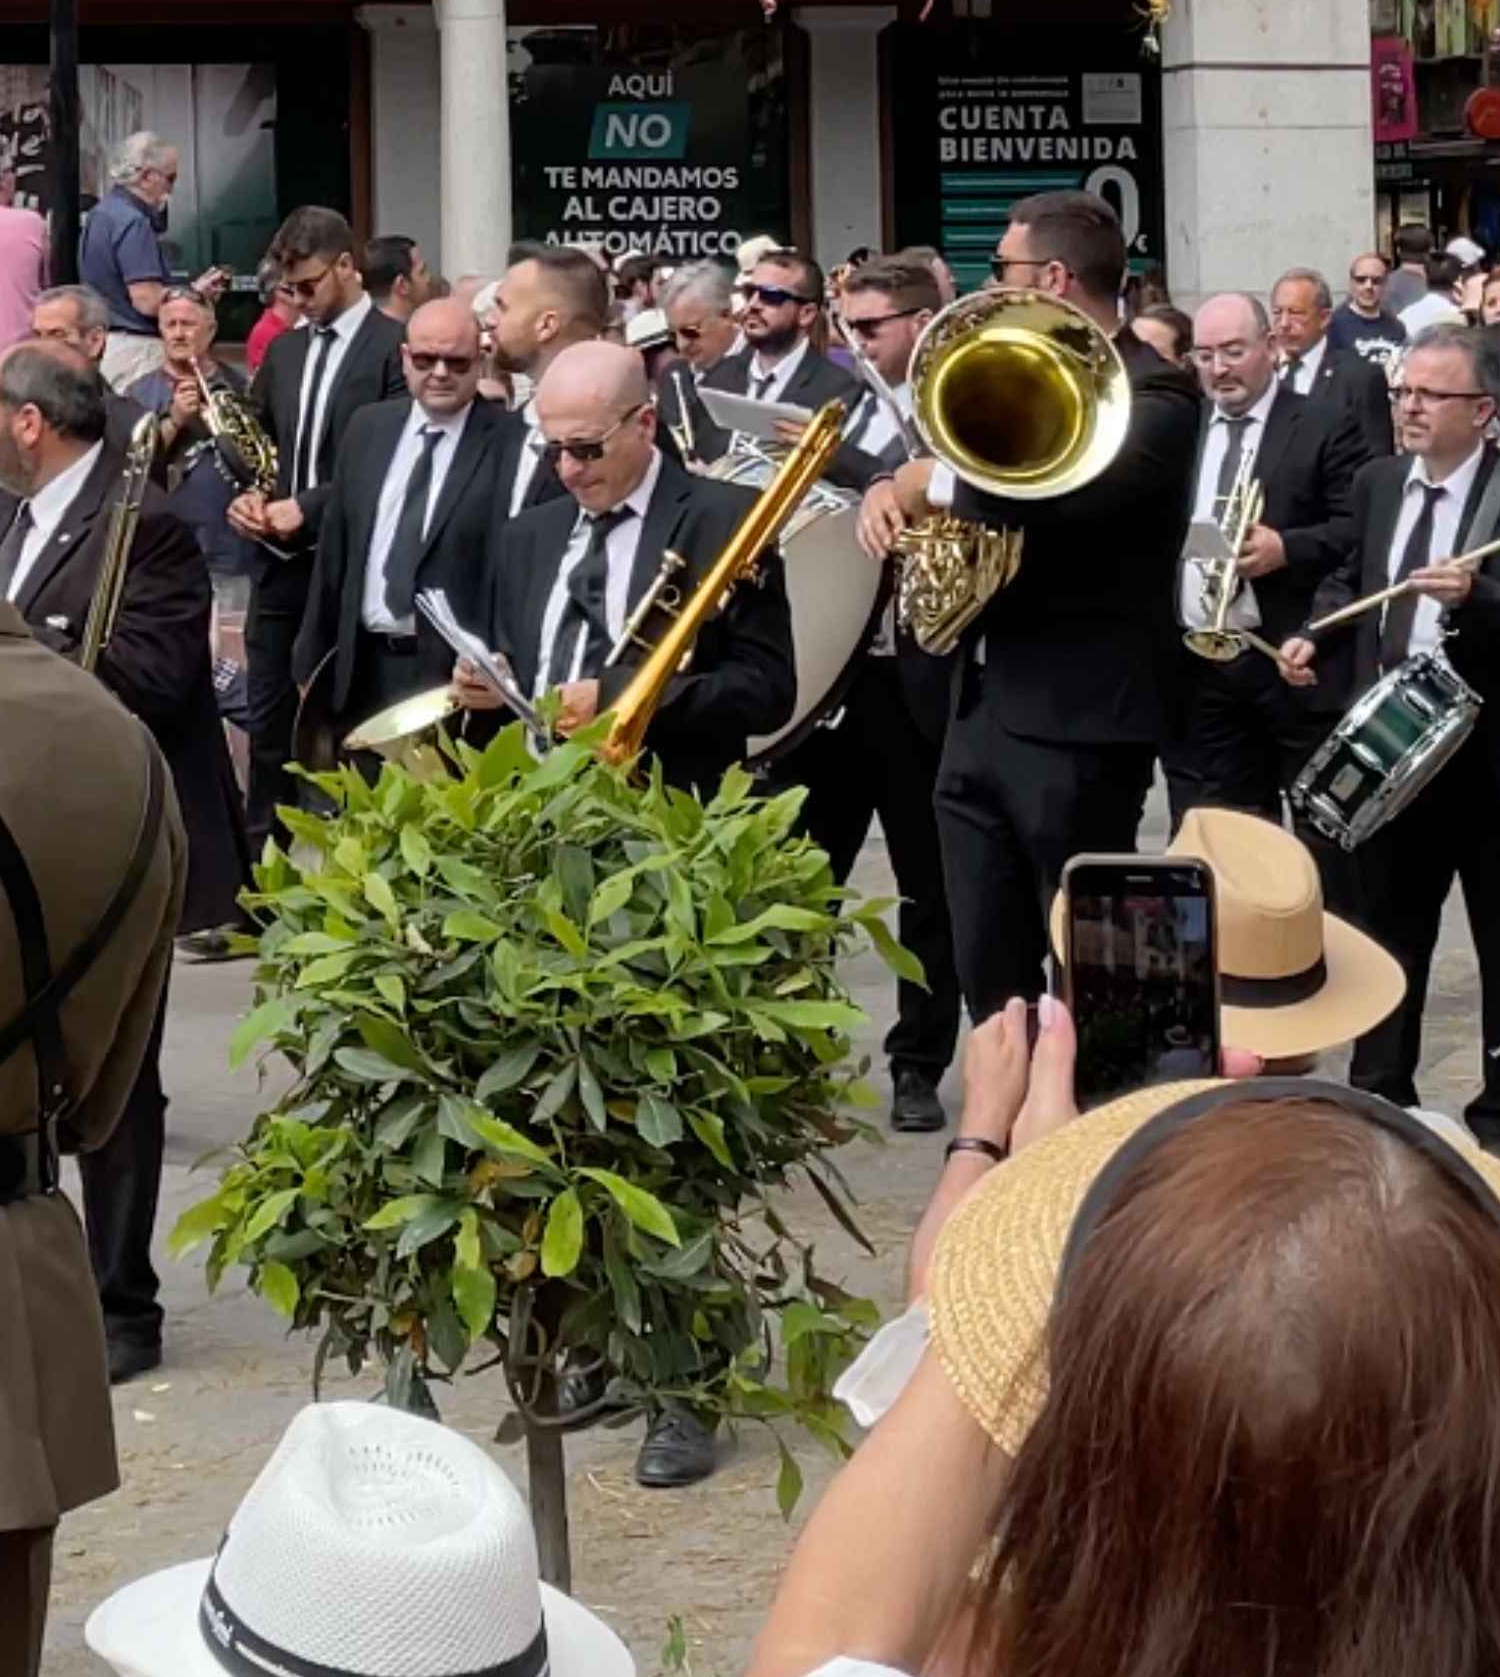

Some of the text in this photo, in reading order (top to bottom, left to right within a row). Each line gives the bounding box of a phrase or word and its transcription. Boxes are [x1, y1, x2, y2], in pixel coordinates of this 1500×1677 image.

[608, 70, 674, 99] AQUÍ
[939, 105, 1070, 130] CUENTA
[605, 113, 672, 148] NO
[940, 137, 1137, 161] BIENVENIDA
[544, 167, 739, 189] TE MANDAMOS
[562, 196, 721, 221] AL CAJERO
